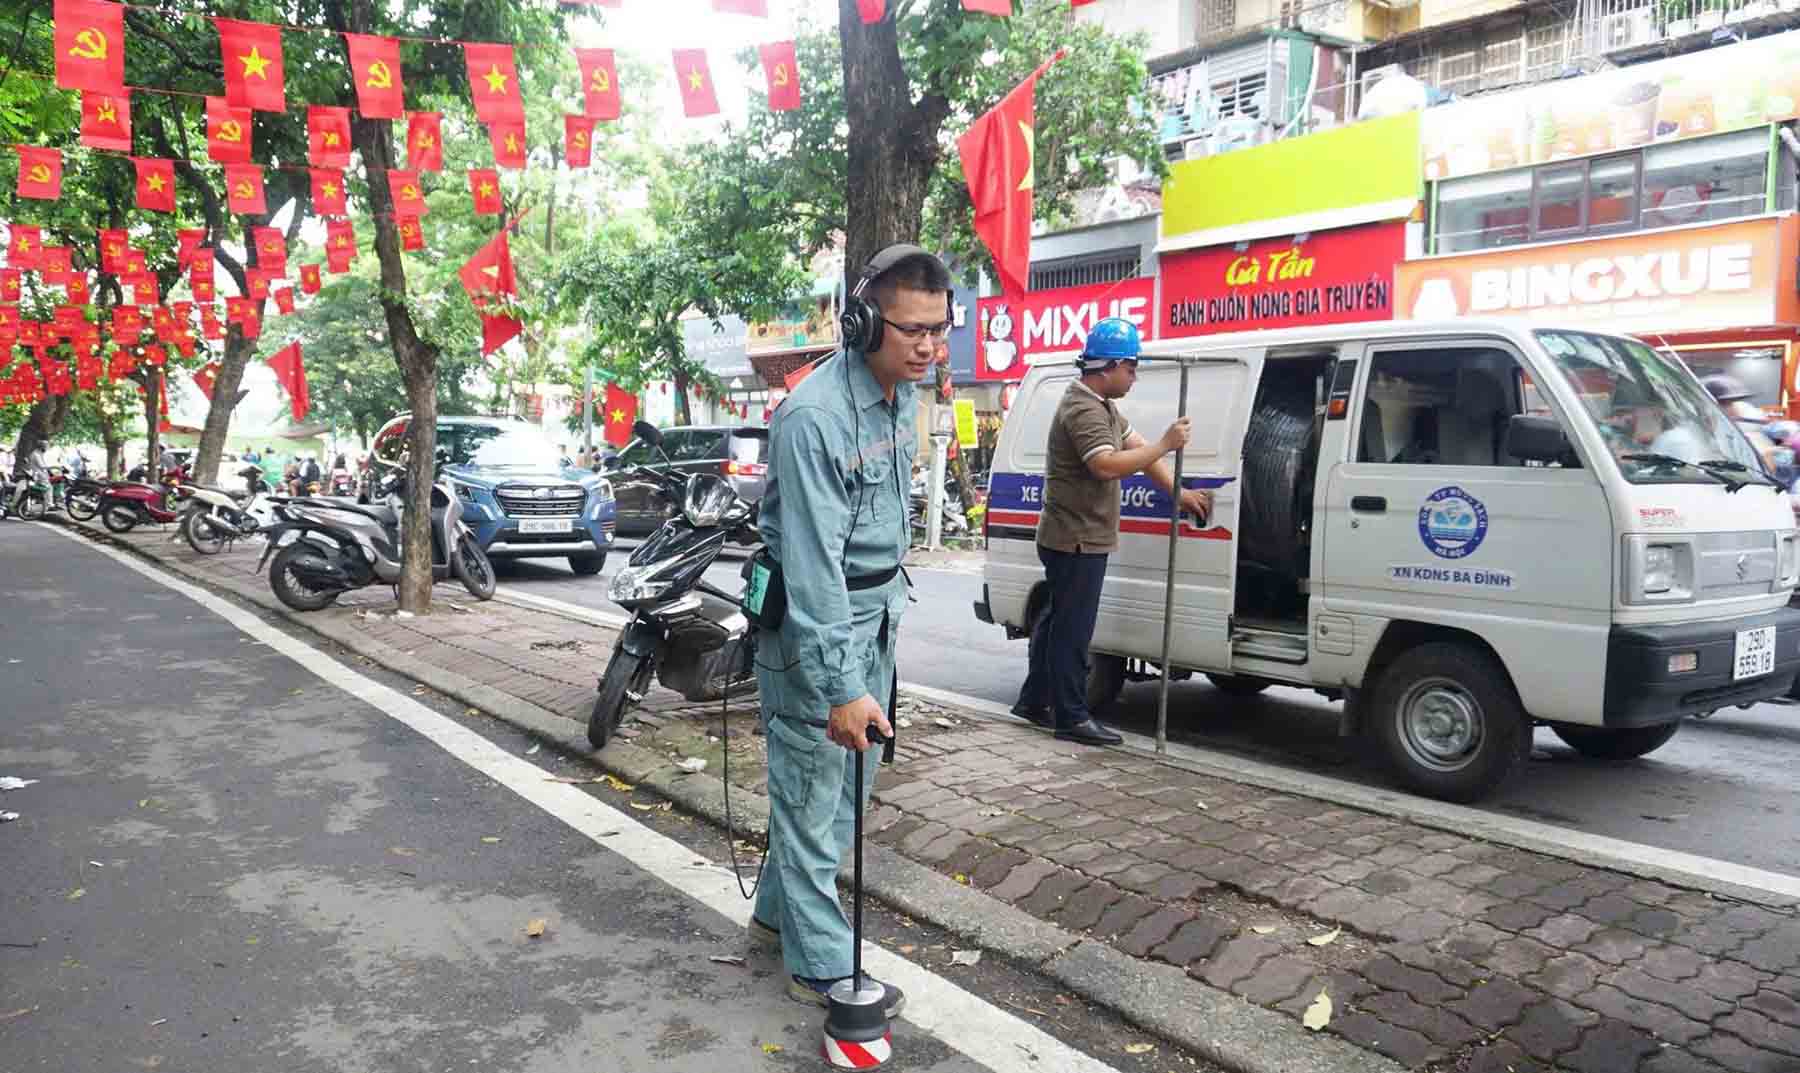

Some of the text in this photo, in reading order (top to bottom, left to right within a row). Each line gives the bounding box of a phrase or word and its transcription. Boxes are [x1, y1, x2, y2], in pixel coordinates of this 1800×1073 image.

[1471, 242, 1753, 311] BINGXUE
[1295, 289, 1322, 315] GIA
[1021, 485, 1040, 503] XE
[1119, 484, 1156, 508] ƯỚC
[1393, 566, 1411, 577] XN
[1414, 568, 1450, 581] KDNS
[1453, 570, 1472, 583] BA
[1747, 630, 1766, 651] 29D
